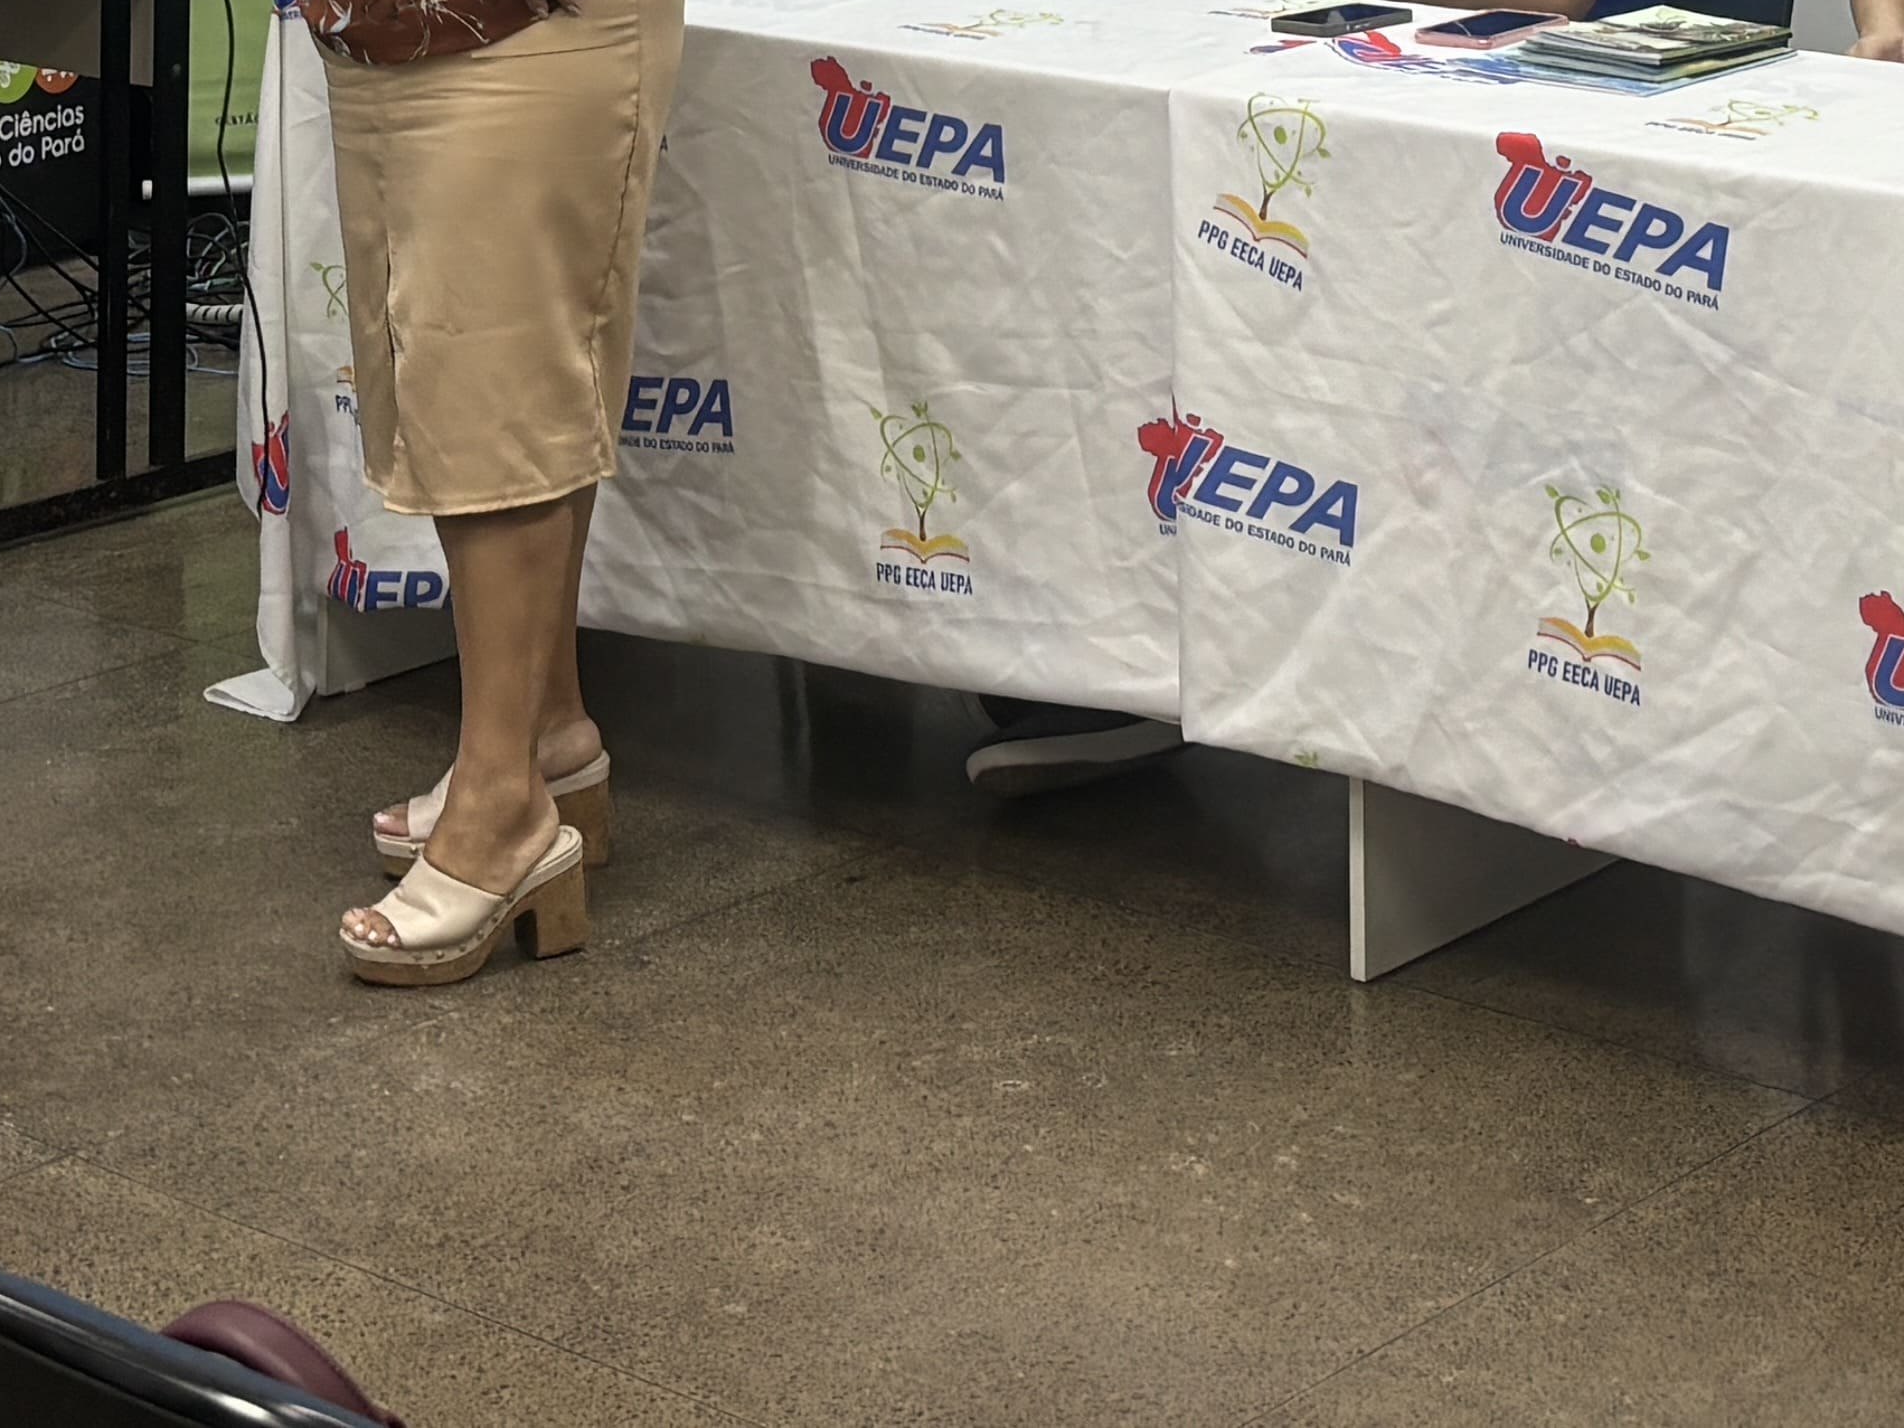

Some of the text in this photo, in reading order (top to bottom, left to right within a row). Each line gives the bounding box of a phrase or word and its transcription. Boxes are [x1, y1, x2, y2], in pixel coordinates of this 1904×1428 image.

[826, 92, 1006, 184] UEPA
[1199, 219, 1305, 292] PPG EECA UEPA
[1501, 166, 1731, 290] UEPA
[1500, 232, 1720, 311] UNIVERSIDADE DO ESTADO DO PARÁ
[1527, 649, 1641, 707] PPG EECA UEPA
